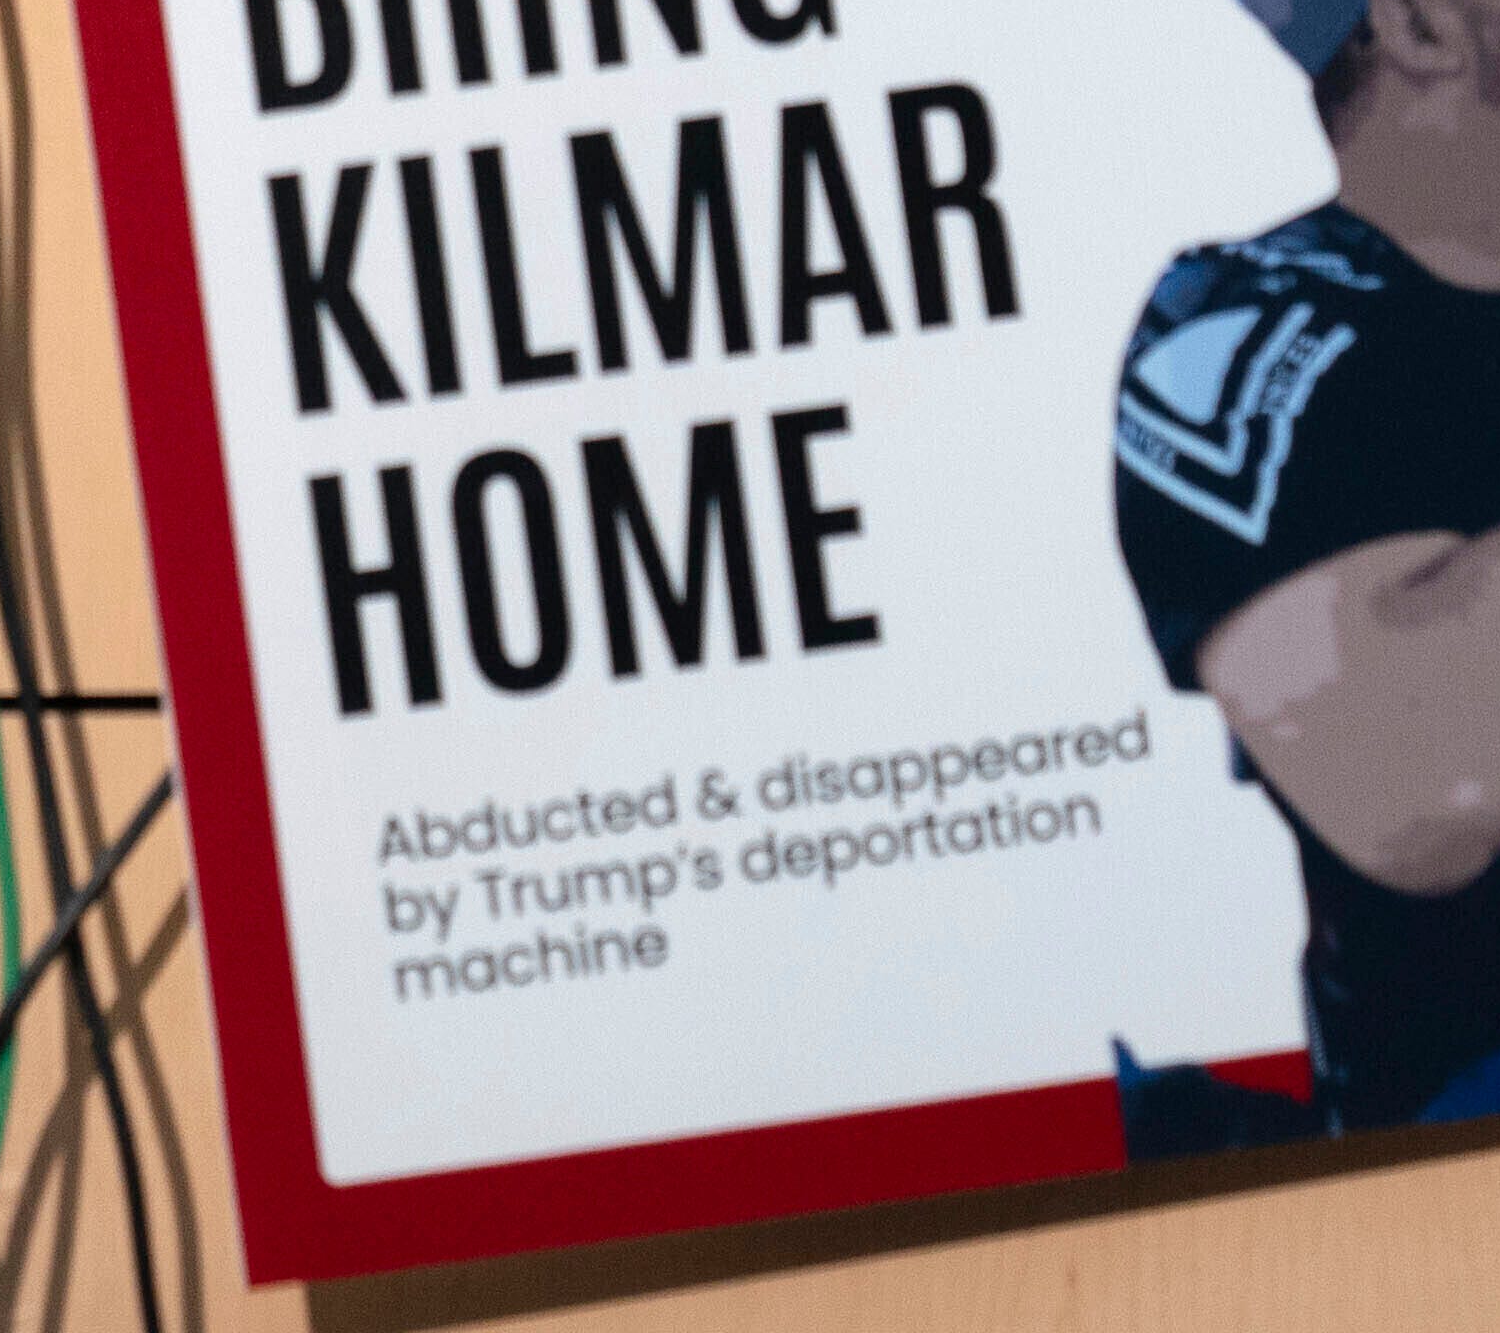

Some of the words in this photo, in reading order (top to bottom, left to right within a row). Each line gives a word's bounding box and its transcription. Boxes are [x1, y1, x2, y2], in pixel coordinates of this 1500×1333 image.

[266, 81, 1021, 416] KILMAR
[308, 403, 882, 717] HOME
[377, 773, 680, 867] Abducted
[696, 771, 740, 821] &
[756, 709, 1153, 817] disappeared
[382, 883, 460, 943] by
[475, 843, 725, 921] Trump's
[738, 793, 1103, 889] deportation
[392, 923, 670, 1003] machine
